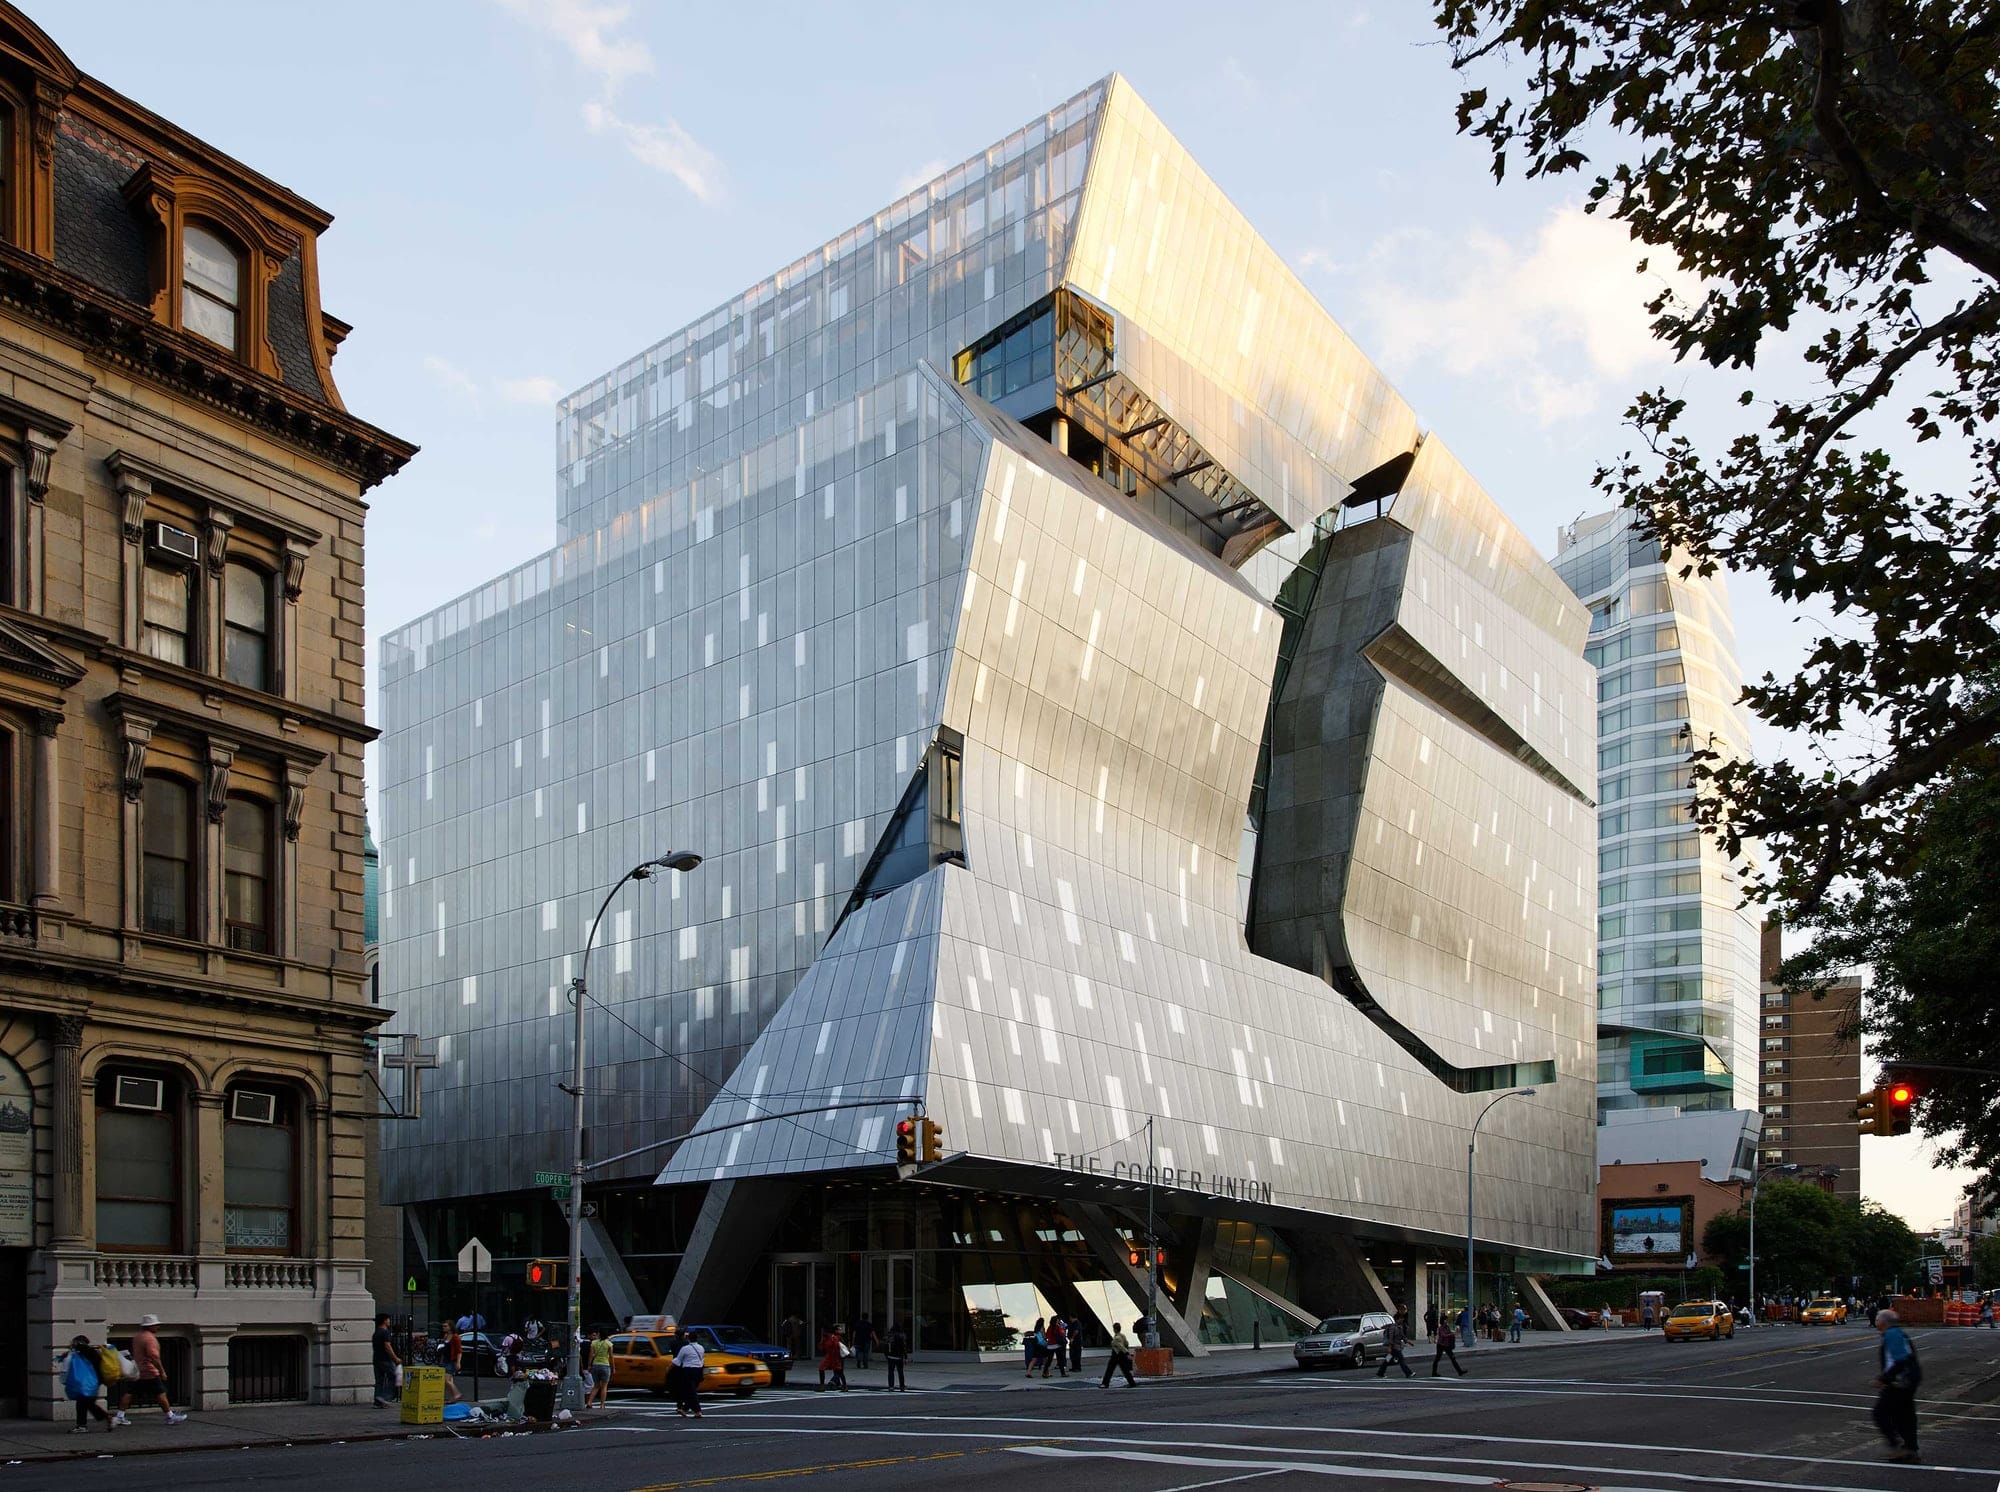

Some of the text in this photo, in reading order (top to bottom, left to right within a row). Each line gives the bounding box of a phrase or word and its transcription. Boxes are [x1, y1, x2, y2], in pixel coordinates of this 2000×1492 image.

[535, 1173, 563, 1185] COOPER
[1053, 1153, 1272, 1205] THE COOPER UNION
